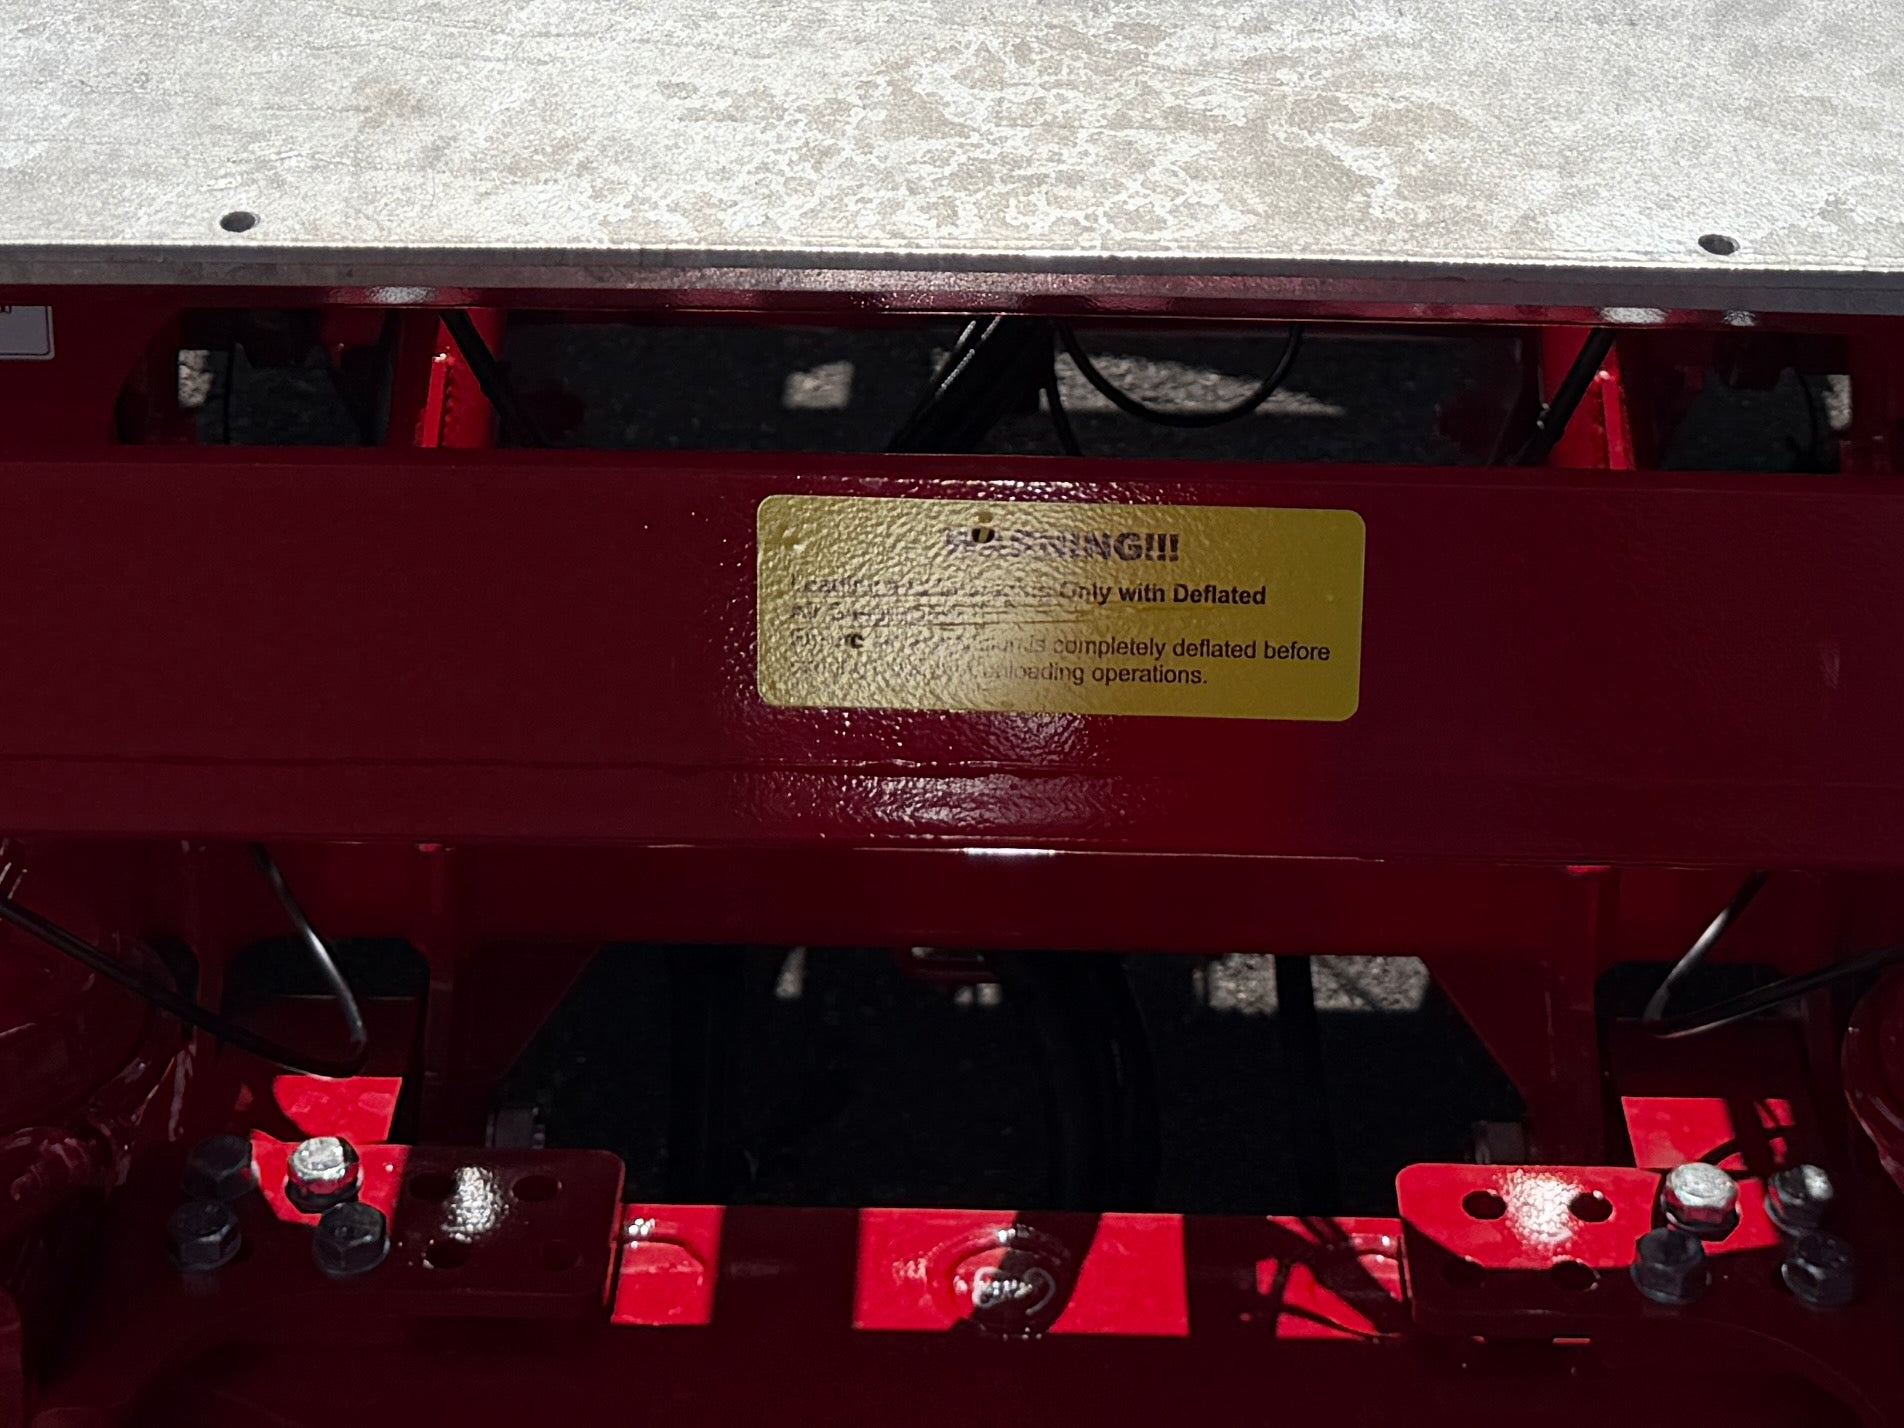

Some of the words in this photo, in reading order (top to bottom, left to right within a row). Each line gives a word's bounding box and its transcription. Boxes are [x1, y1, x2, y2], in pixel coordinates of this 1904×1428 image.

[944, 526, 1180, 562] NING!!!
[1059, 580, 1111, 606] Only
[1118, 583, 1165, 603] with
[1173, 584, 1267, 605] Deflated
[1053, 636, 1166, 661] completely
[1172, 638, 1256, 660] deflated
[1263, 640, 1331, 661] before
[1092, 664, 1208, 686] operations.
